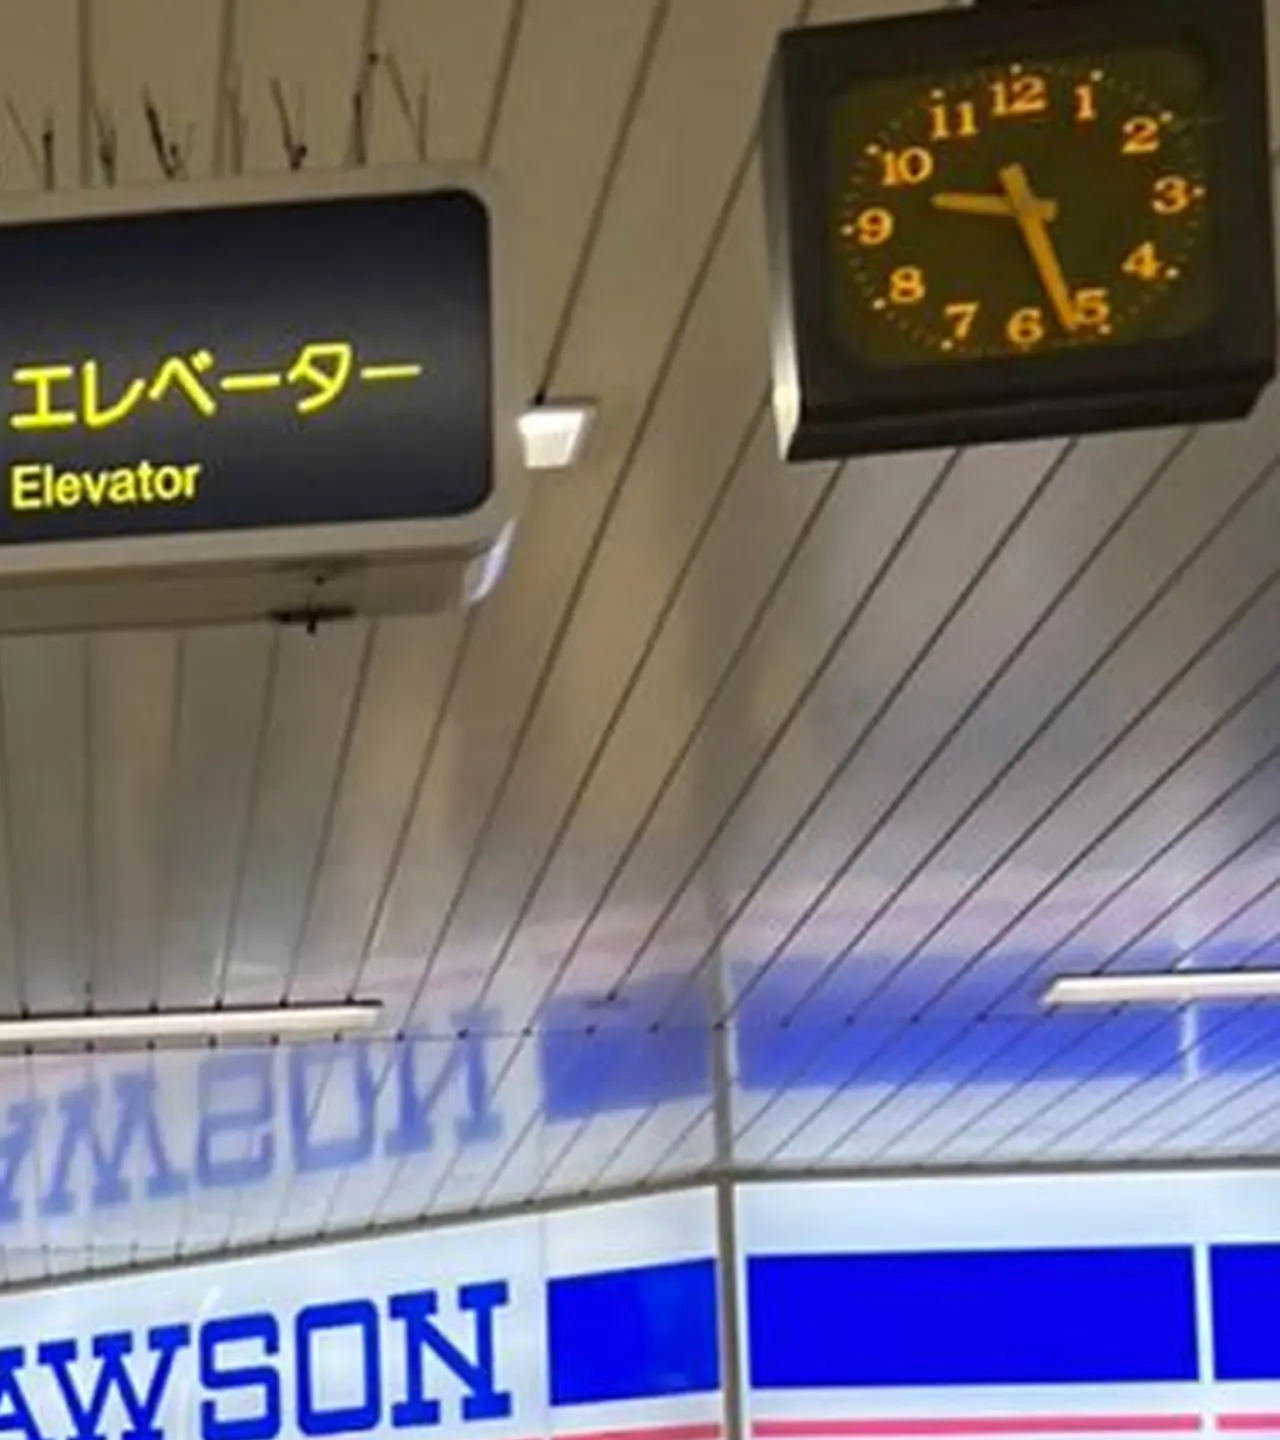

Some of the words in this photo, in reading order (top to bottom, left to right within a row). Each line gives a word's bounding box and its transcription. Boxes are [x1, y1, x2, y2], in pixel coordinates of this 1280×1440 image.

[991, 75, 1047, 117] 12
[1074, 83, 1098, 121] 1
[929, 102, 978, 141] 11
[1122, 116, 1160, 155] 2
[881, 146, 934, 187] 10
[1151, 174, 1190, 215] 3
[856, 207, 894, 246] 9
[1121, 241, 1159, 281] 4
[888, 265, 926, 304] 8
[943, 302, 980, 339] 7
[1006, 306, 1044, 345] 6
[1076, 287, 1111, 325] 5
[9, 342, 425, 431] エレベーター
[10, 460, 203, 511] Elevator
